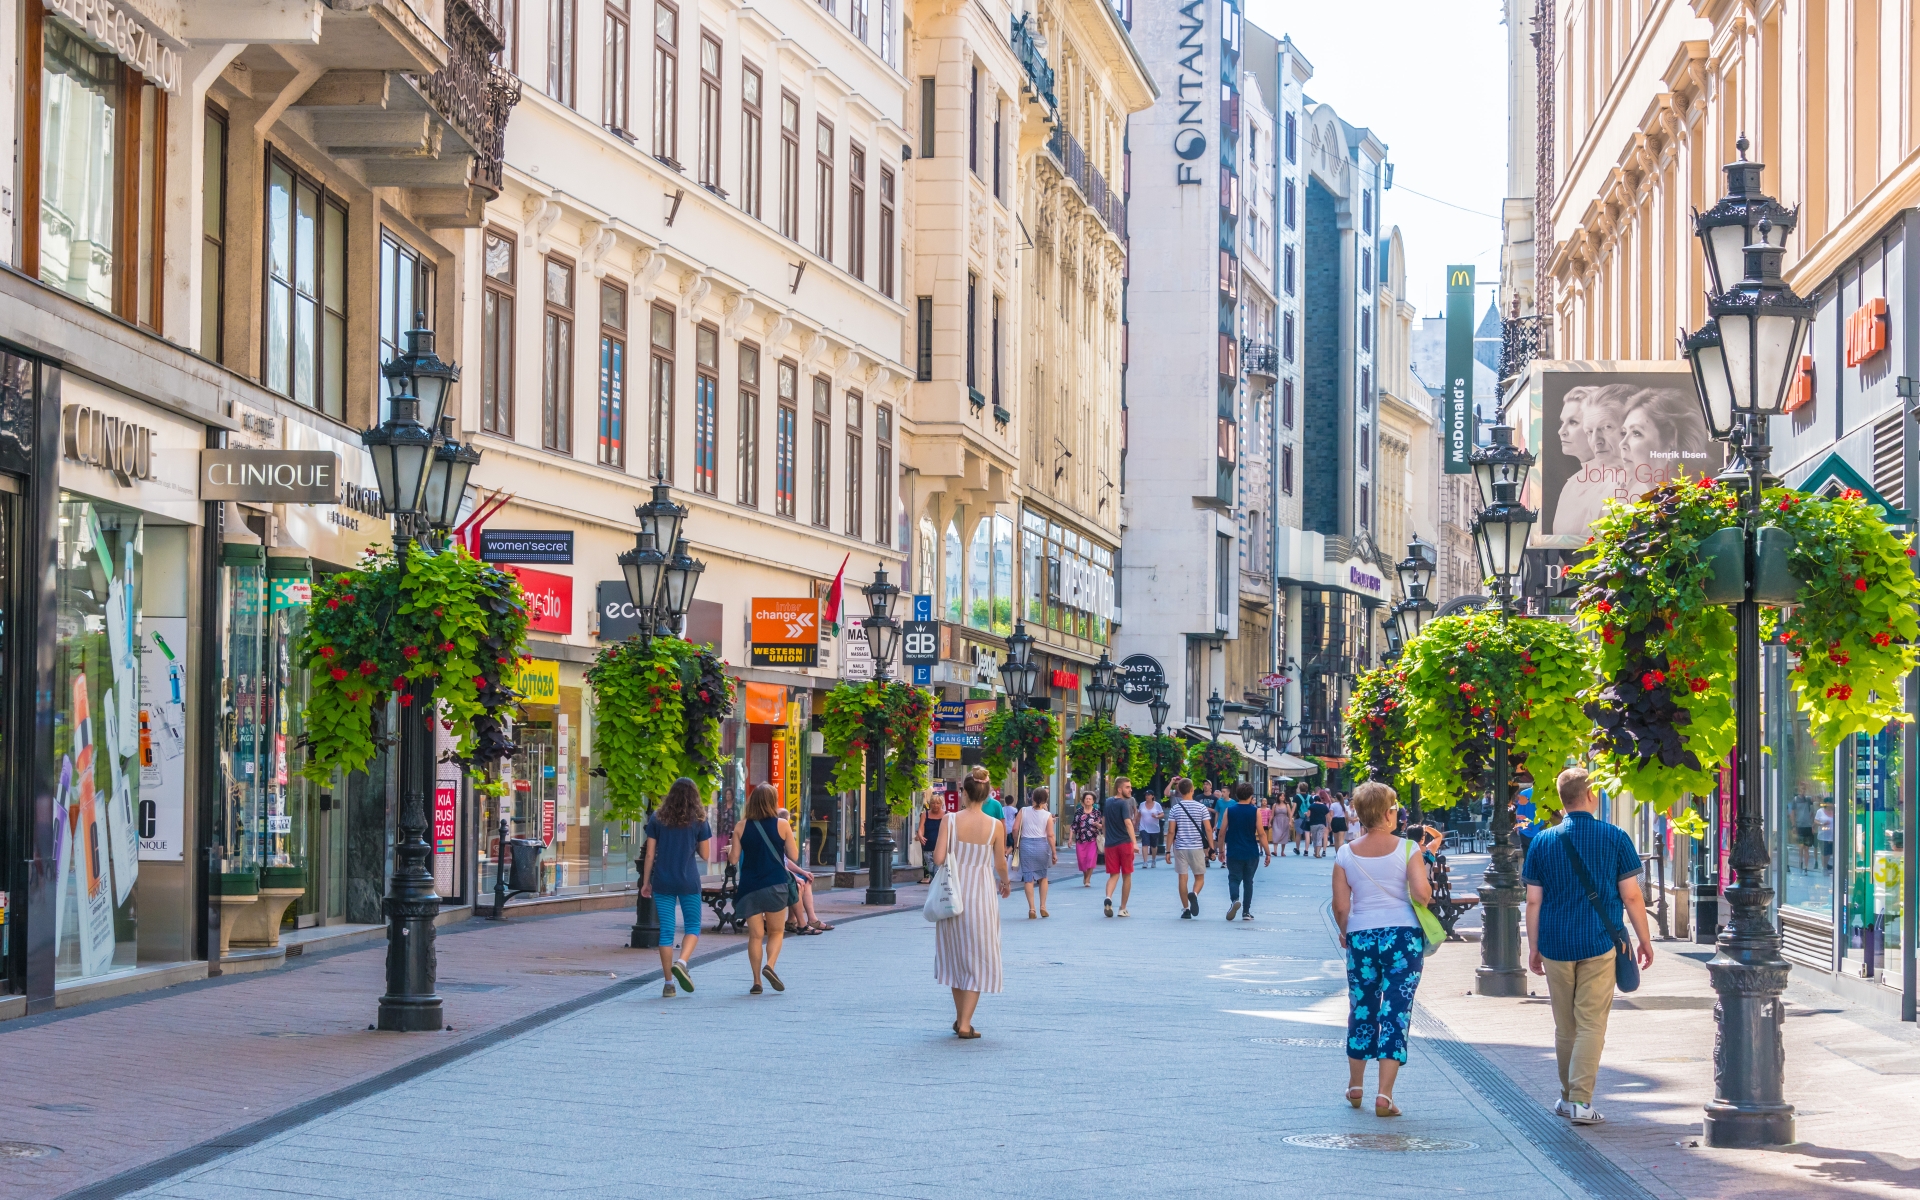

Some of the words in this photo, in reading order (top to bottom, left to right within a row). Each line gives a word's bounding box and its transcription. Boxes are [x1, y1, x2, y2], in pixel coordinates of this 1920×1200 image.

[1175, 0, 1207, 186] FONTANA
[1452, 378, 1465, 463] McDonald's
[62, 403, 158, 488] CLINIQUE
[1650, 450, 1680, 459] Henrik
[1681, 450, 1707, 459] Ibsen
[207, 462, 330, 491] CLINIQUE
[1576, 463, 1627, 484] John
[487, 540, 568, 552] women'secret
[1060, 554, 1116, 620] RESERVED
[776, 601, 802, 612] inter
[756, 609, 797, 622] change
[753, 647, 803, 655] WESTERN
[769, 654, 803, 663] UNION
[1123, 664, 1156, 673] PASTA
[936, 703, 964, 715] hange
[437, 791, 452, 807] KIÁ
[435, 807, 455, 822] RUSÍ
[435, 821, 454, 837] TÁS!
